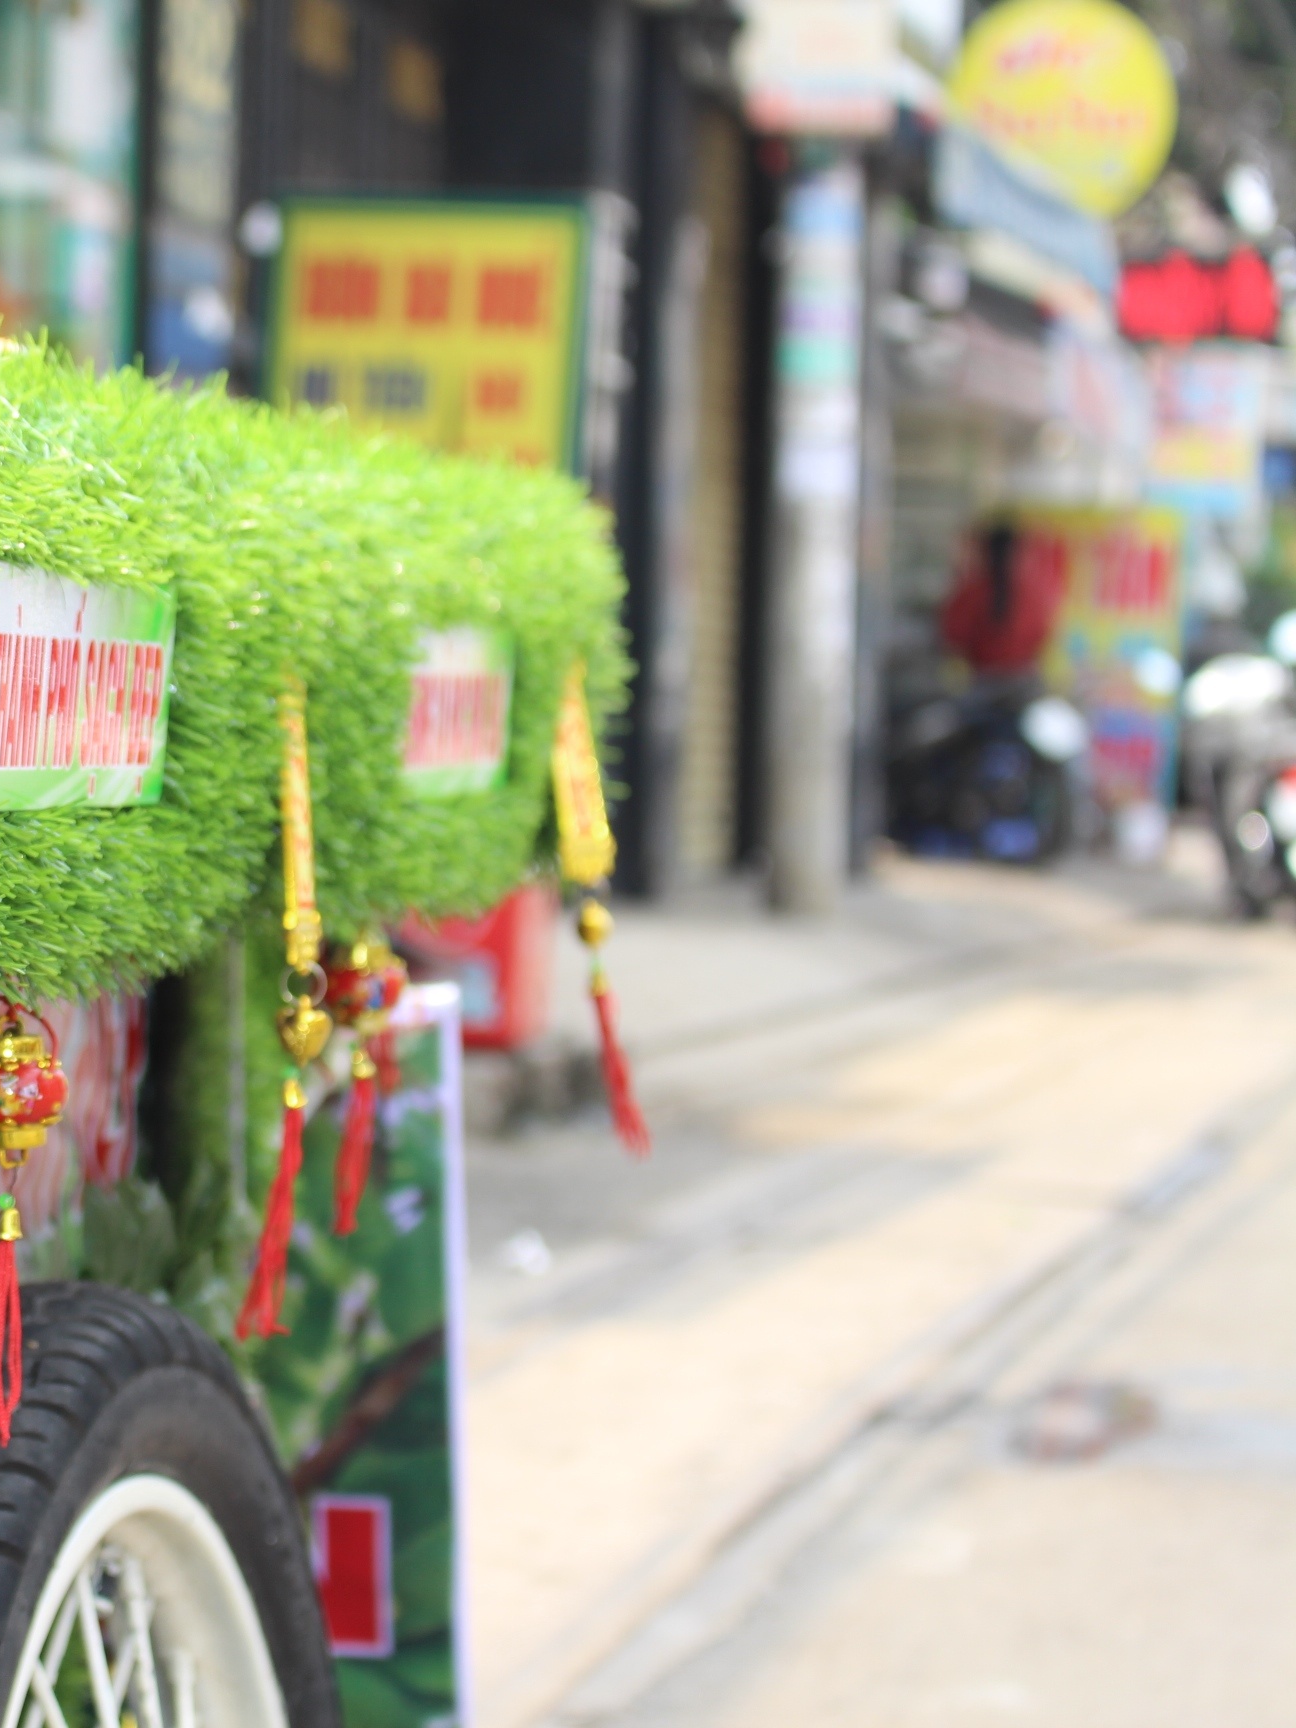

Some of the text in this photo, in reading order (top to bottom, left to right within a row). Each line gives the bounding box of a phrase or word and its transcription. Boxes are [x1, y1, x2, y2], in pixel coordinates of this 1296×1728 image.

[42, 590, 89, 768] PHỐ
[79, 639, 130, 796] SẠCH
[125, 643, 163, 795] ĐẸP
